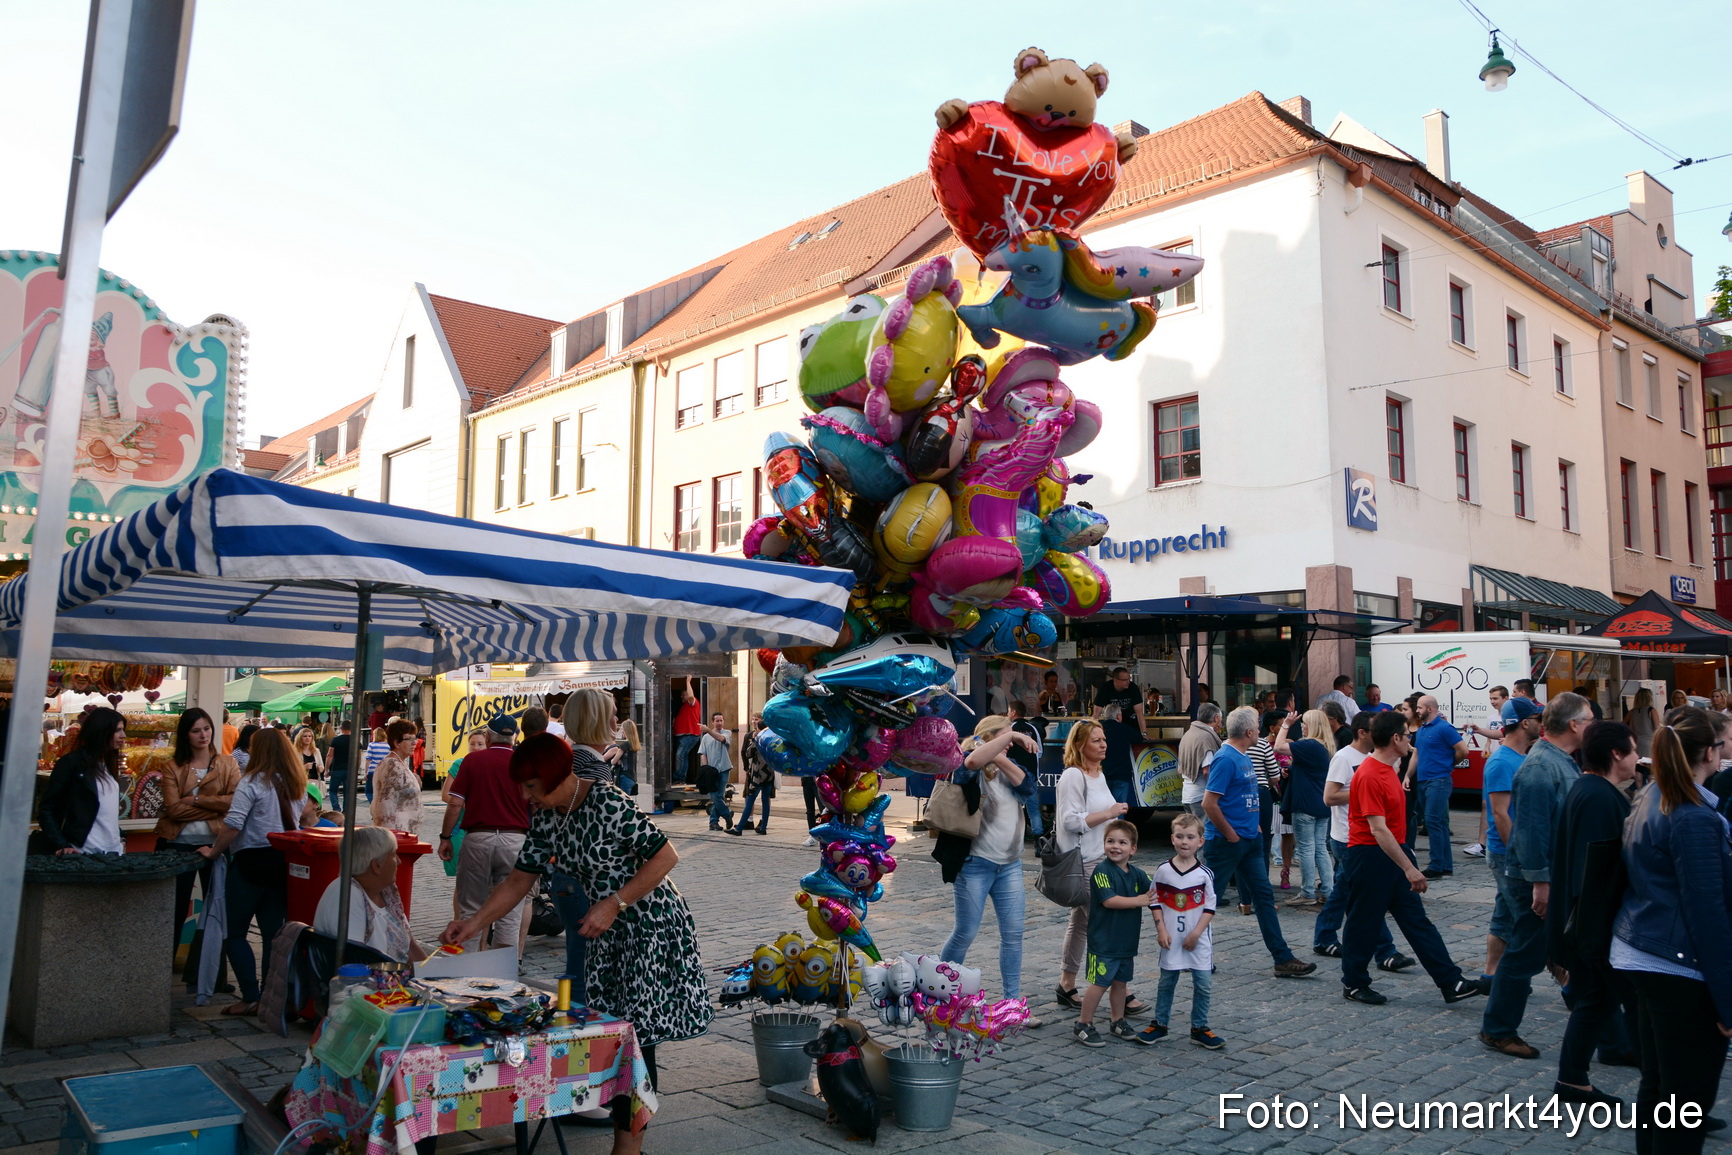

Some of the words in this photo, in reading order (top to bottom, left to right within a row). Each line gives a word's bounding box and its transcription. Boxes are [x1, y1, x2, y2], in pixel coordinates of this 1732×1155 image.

[977, 123, 1008, 160] I
[1013, 132, 1075, 176] Love
[1078, 149, 1117, 187] You
[993, 167, 1081, 229] This
[1099, 524, 1227, 564] Rupprecht
[558, 676, 628, 691] Baumstriezel
[1455, 701, 1487, 713] Pizzeria
[1140, 759, 1177, 793] Glossner
[1155, 780, 1175, 791] GOLD
[1176, 915, 1186, 932] 5
